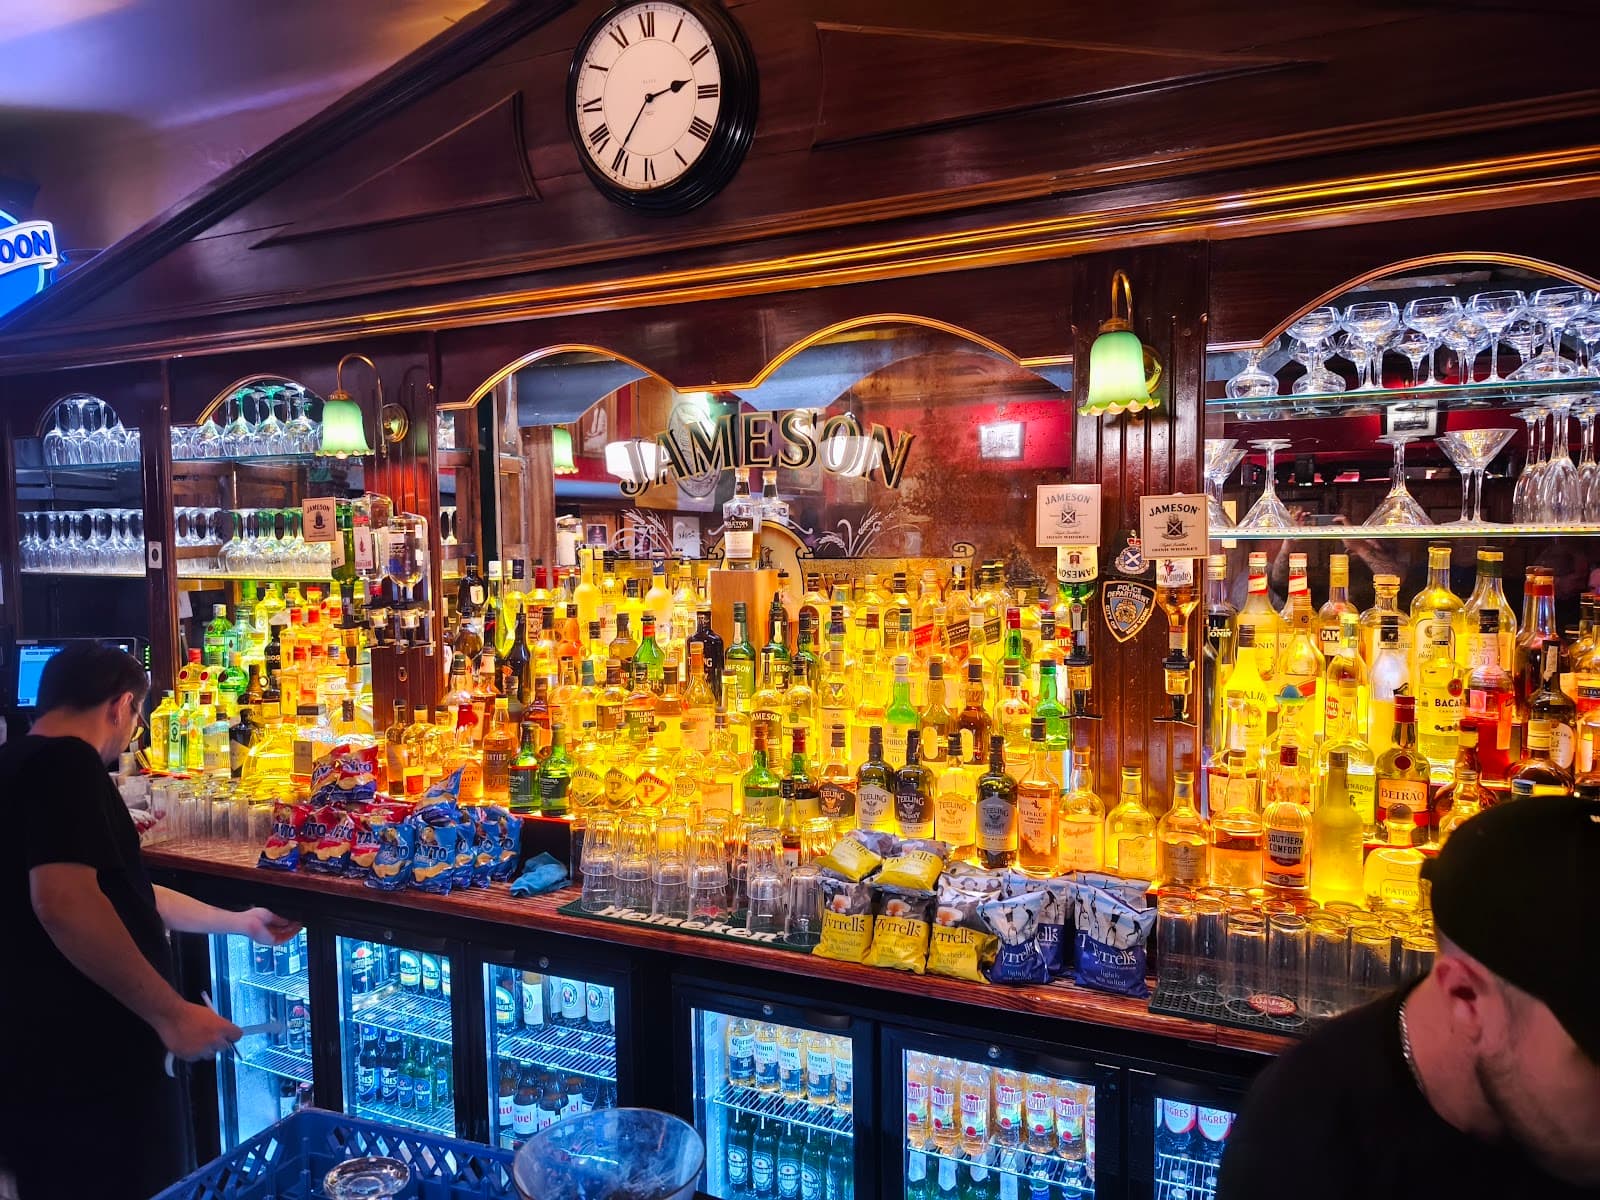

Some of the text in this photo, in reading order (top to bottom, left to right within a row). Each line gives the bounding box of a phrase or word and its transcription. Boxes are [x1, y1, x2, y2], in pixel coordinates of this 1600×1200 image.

[637, 11, 656, 38] XII
[689, 44, 711, 66] II
[697, 83, 719, 100] III
[619, 410, 916, 498] JAMESON
[1045, 492, 1091, 505] JAMESON
[306, 503, 331, 514] JAMESON
[1149, 502, 1198, 517] JAMESON
[1058, 566, 1095, 579] JAMESON
[1117, 584, 1142, 594] POLICE
[1106, 589, 1151, 605] DEPARTMENT
[1125, 607, 1151, 635] NEW YORK
[1321, 630, 1340, 641] CAM
[643, 785, 656, 798] P
[820, 789, 845, 801] TEELING
[859, 793, 887, 804] TEELING
[896, 794, 925, 806] TEELING
[938, 801, 967, 812] TEELING
[982, 807, 1009, 817] TEELING
[1268, 833, 1304, 846] SOUTHERN
[1269, 843, 1302, 855] COMFORT
[824, 912, 865, 932] Tyrrells
[876, 918, 922, 938] Tyrrells
[1001, 942, 1036, 965] yrrells
[1092, 940, 1137, 966] Tyrrells
